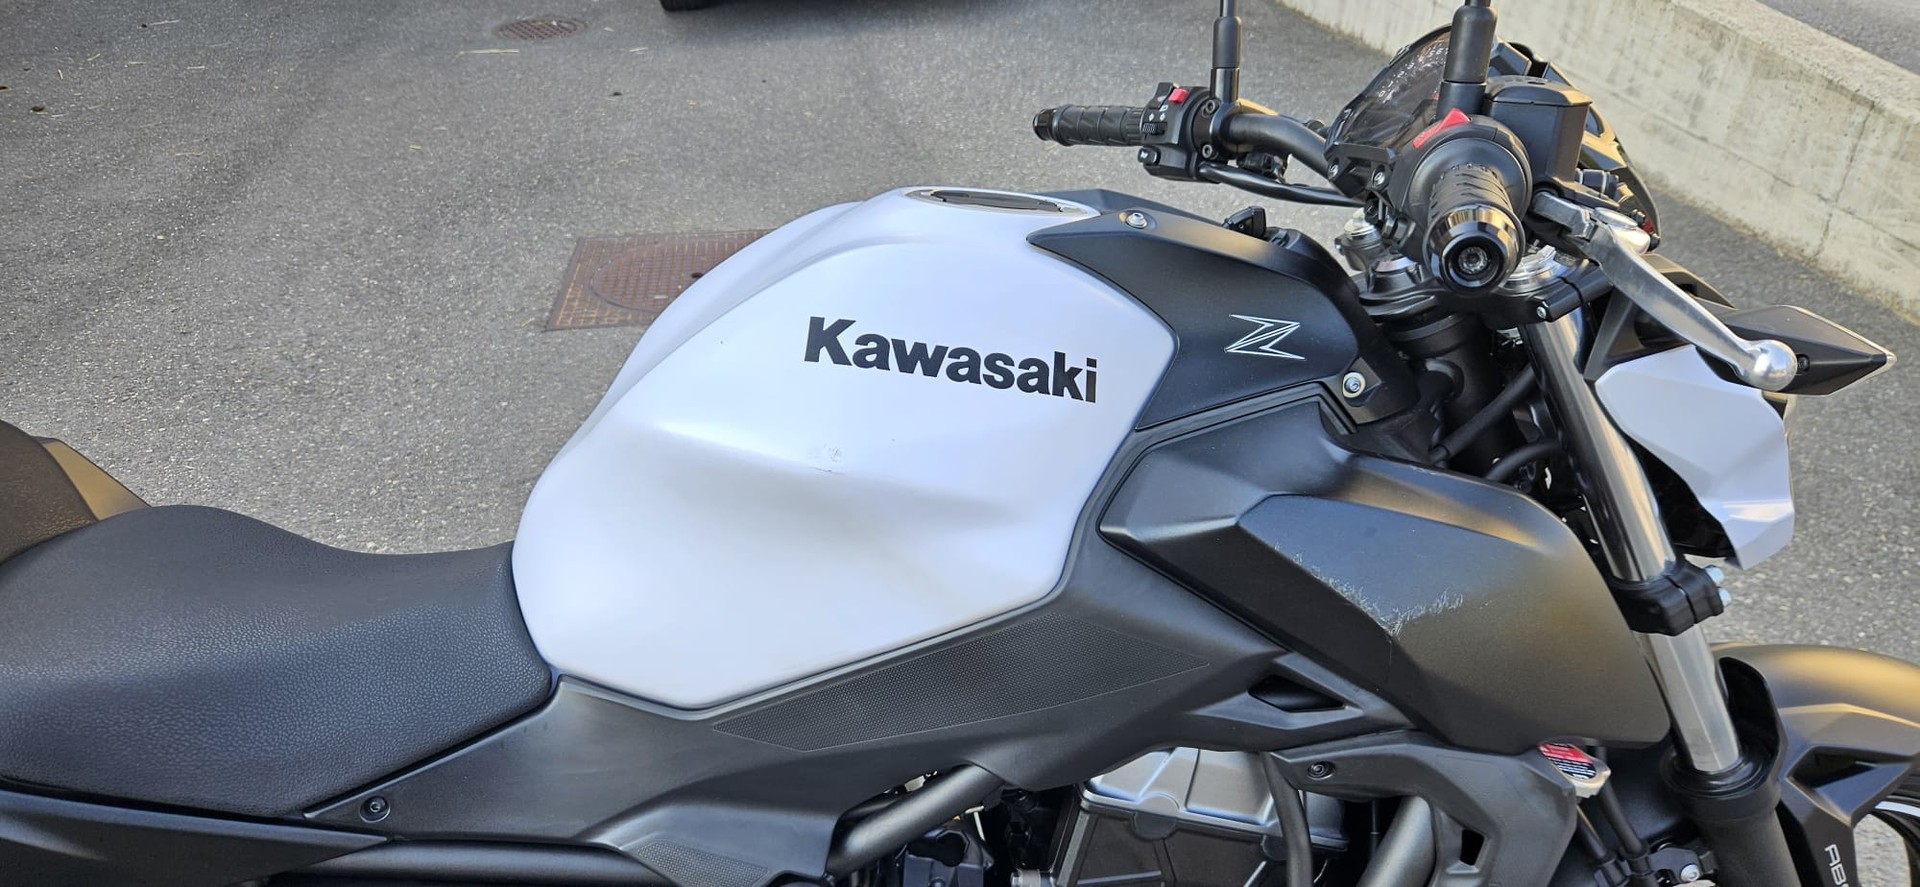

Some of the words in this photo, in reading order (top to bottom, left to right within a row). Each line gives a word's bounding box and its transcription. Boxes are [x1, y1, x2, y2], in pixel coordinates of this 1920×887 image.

[804, 316, 1097, 403] Kawasaki
[1224, 314, 1306, 360] Z
[1824, 844, 1849, 887] AB
